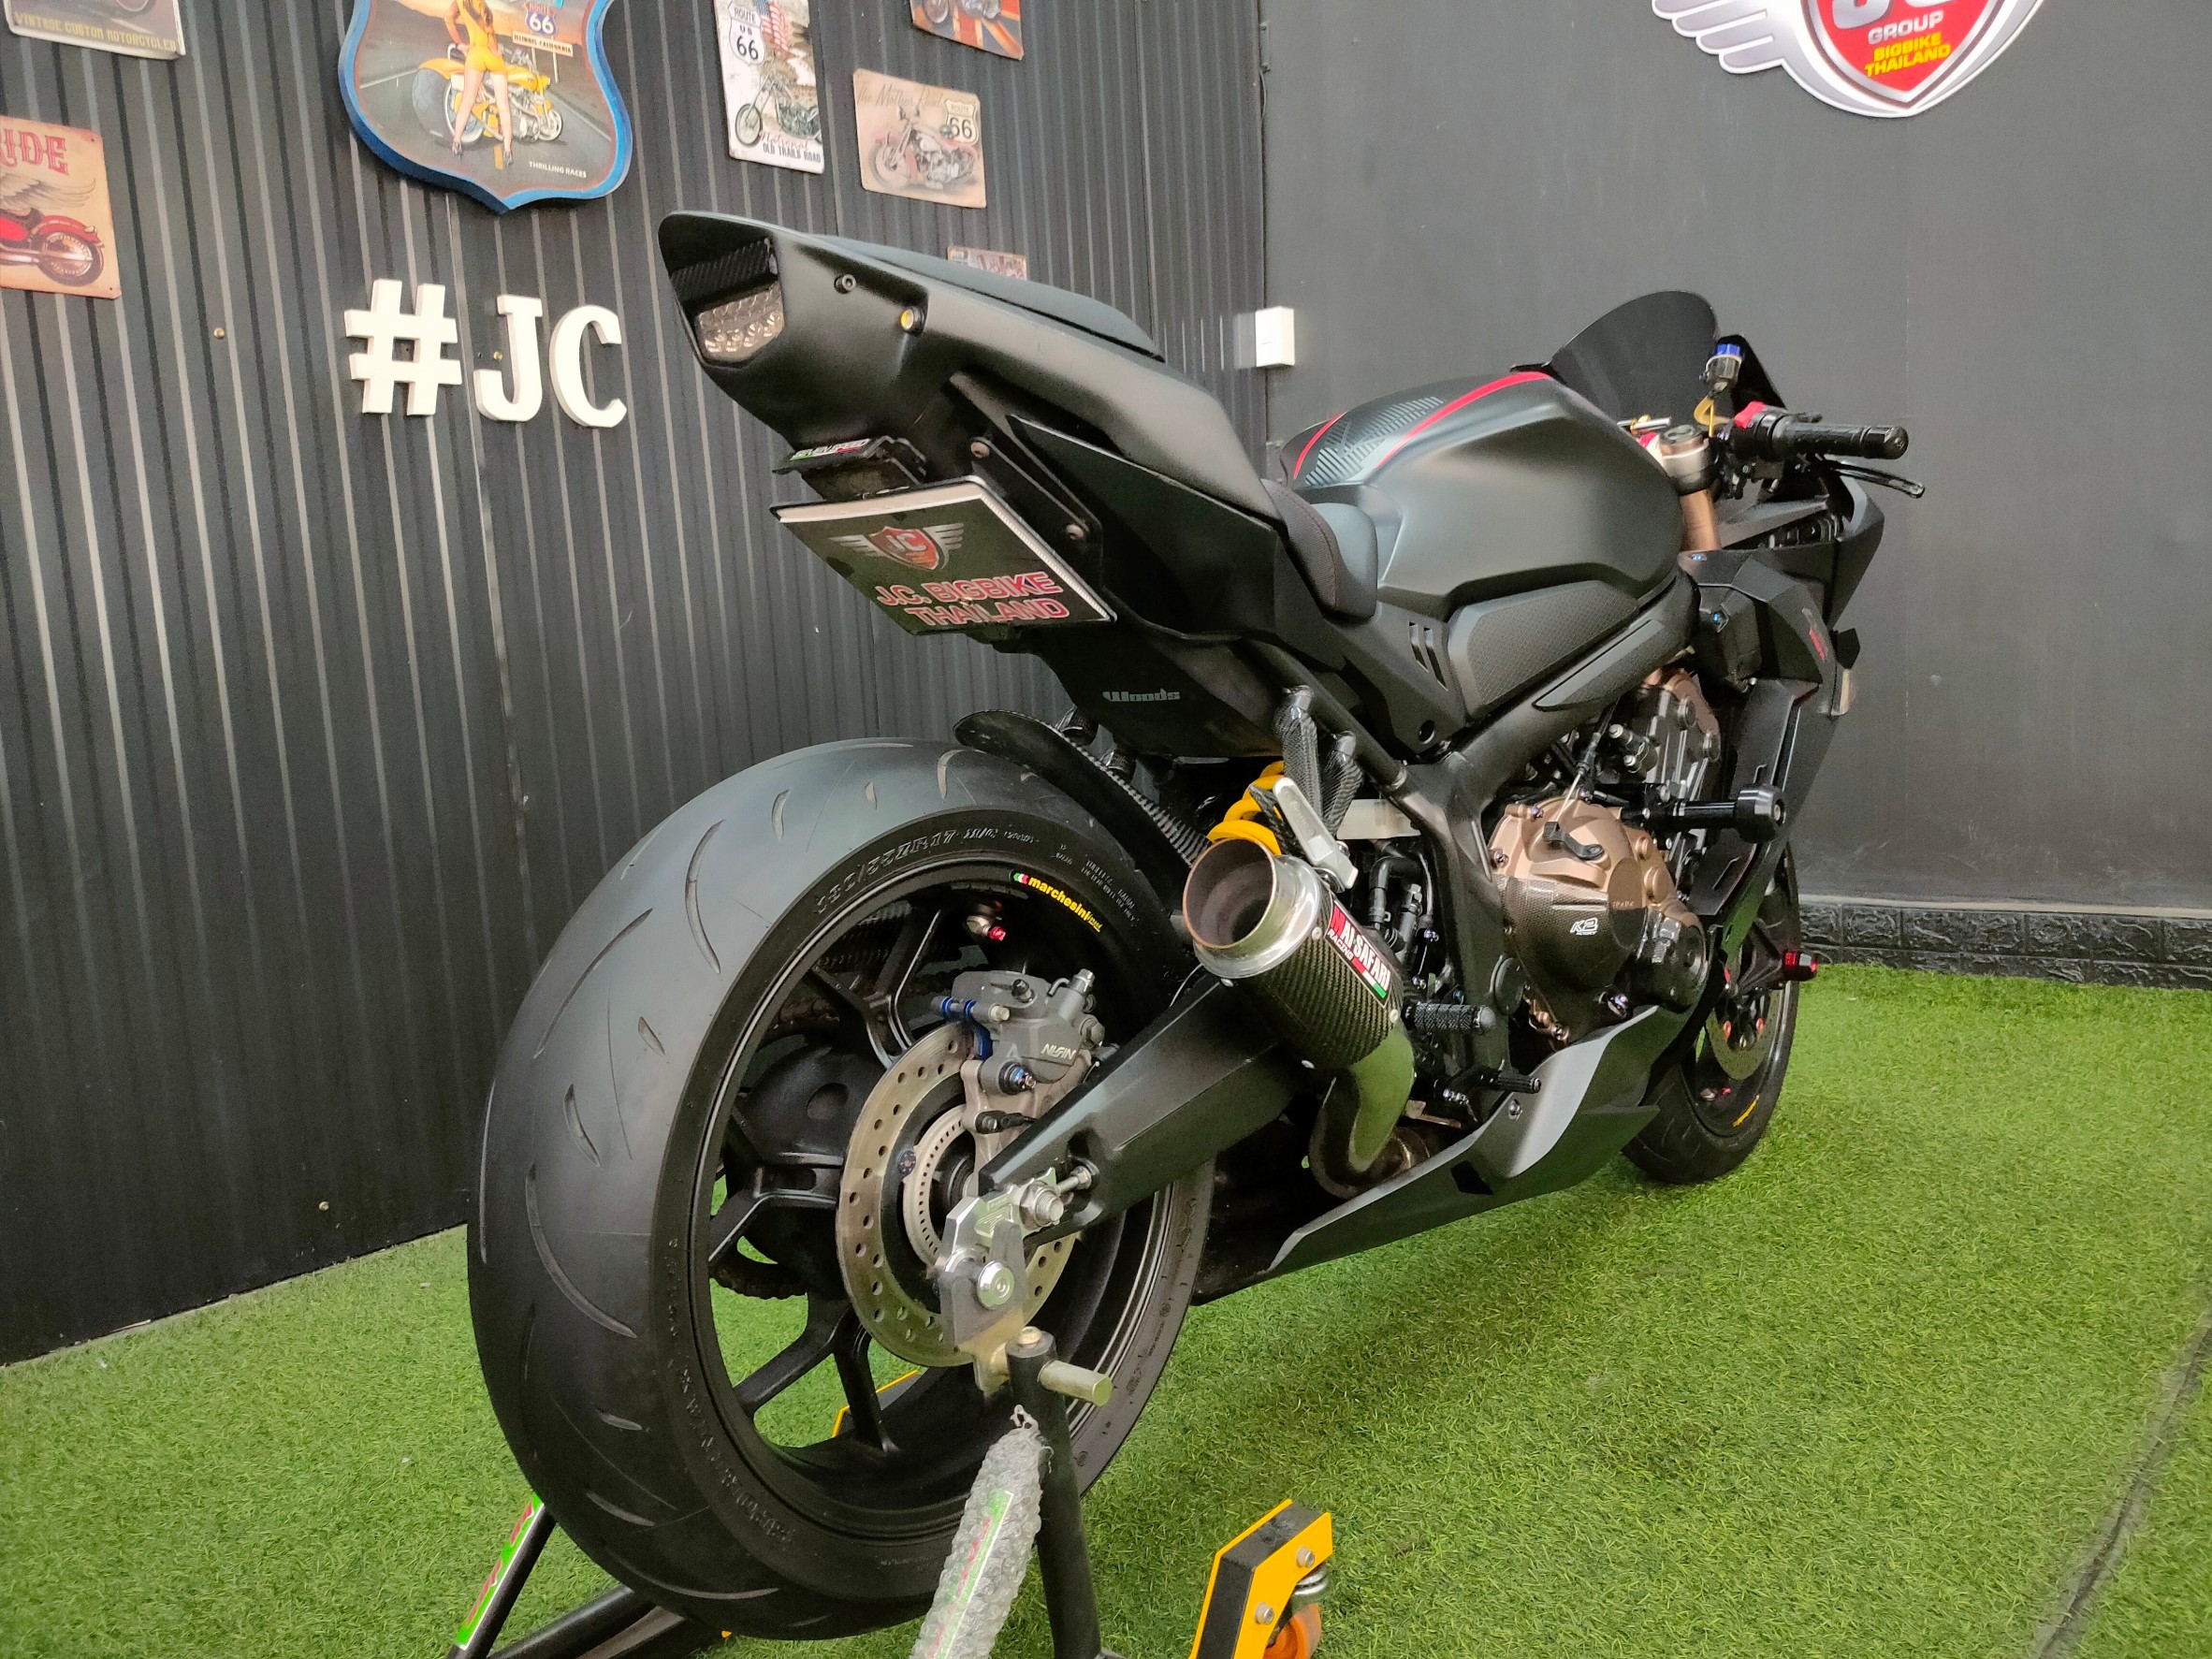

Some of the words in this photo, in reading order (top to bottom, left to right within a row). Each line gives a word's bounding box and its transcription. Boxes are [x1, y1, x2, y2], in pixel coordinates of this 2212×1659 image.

[529, 12, 554, 35] 66
[734, 7, 756, 23] ROUTE
[1868, 10, 1944, 45] GROUP
[736, 35, 759, 60] 66
[1864, 44, 1951, 78] THAILAND
[1873, 32, 1942, 63] BIGBIKE
[949, 116, 972, 139] 66
[921, 571, 1064, 604] BIGBIKE
[903, 598, 1070, 626] THAILAND
[1027, 876, 1092, 923] marchesini
[1328, 927, 1355, 961] RACING
